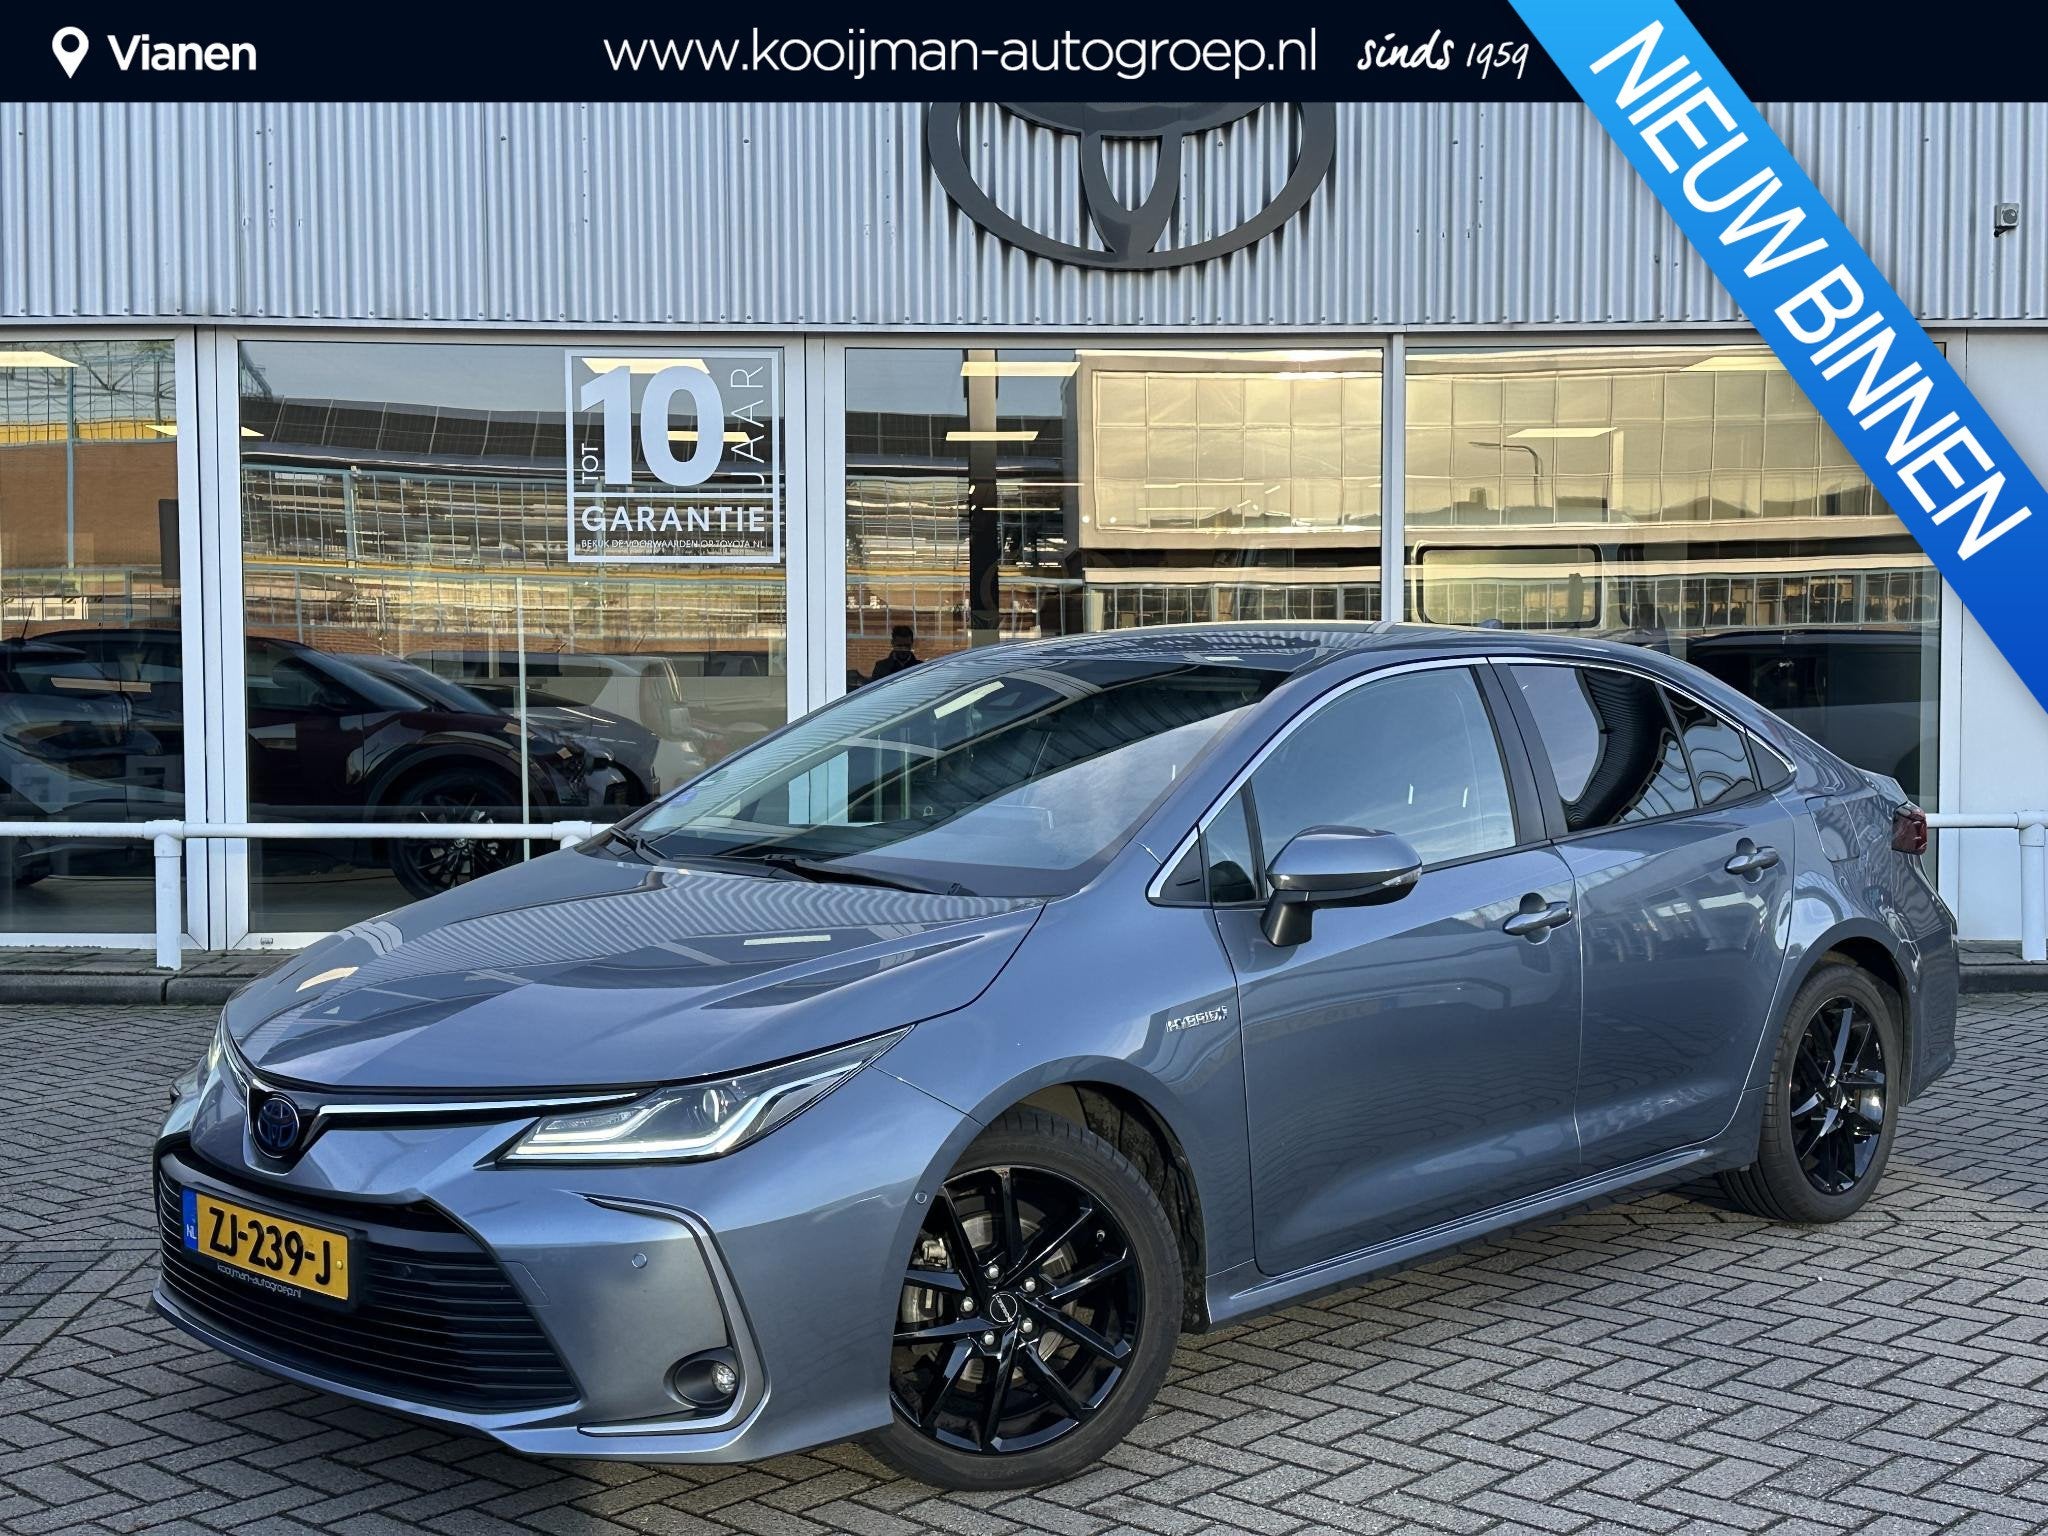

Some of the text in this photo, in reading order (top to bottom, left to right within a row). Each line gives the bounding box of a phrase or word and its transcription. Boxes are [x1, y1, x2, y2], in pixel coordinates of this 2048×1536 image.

[580, 365, 725, 487] 10
[730, 365, 766, 487] JAAR
[581, 443, 599, 485] TOT
[581, 506, 766, 533] GARANTIE
[611, 539, 624, 549] DE
[626, 539, 698, 549] VOORWAARDEN
[700, 539, 714, 549] OP
[1165, 1007, 1222, 1033] HYBRID
[186, 1223, 198, 1241] NL
[209, 1206, 332, 1286] ZJ-239-J
[216, 1262, 301, 1298] kooijman-autogroep.nl
